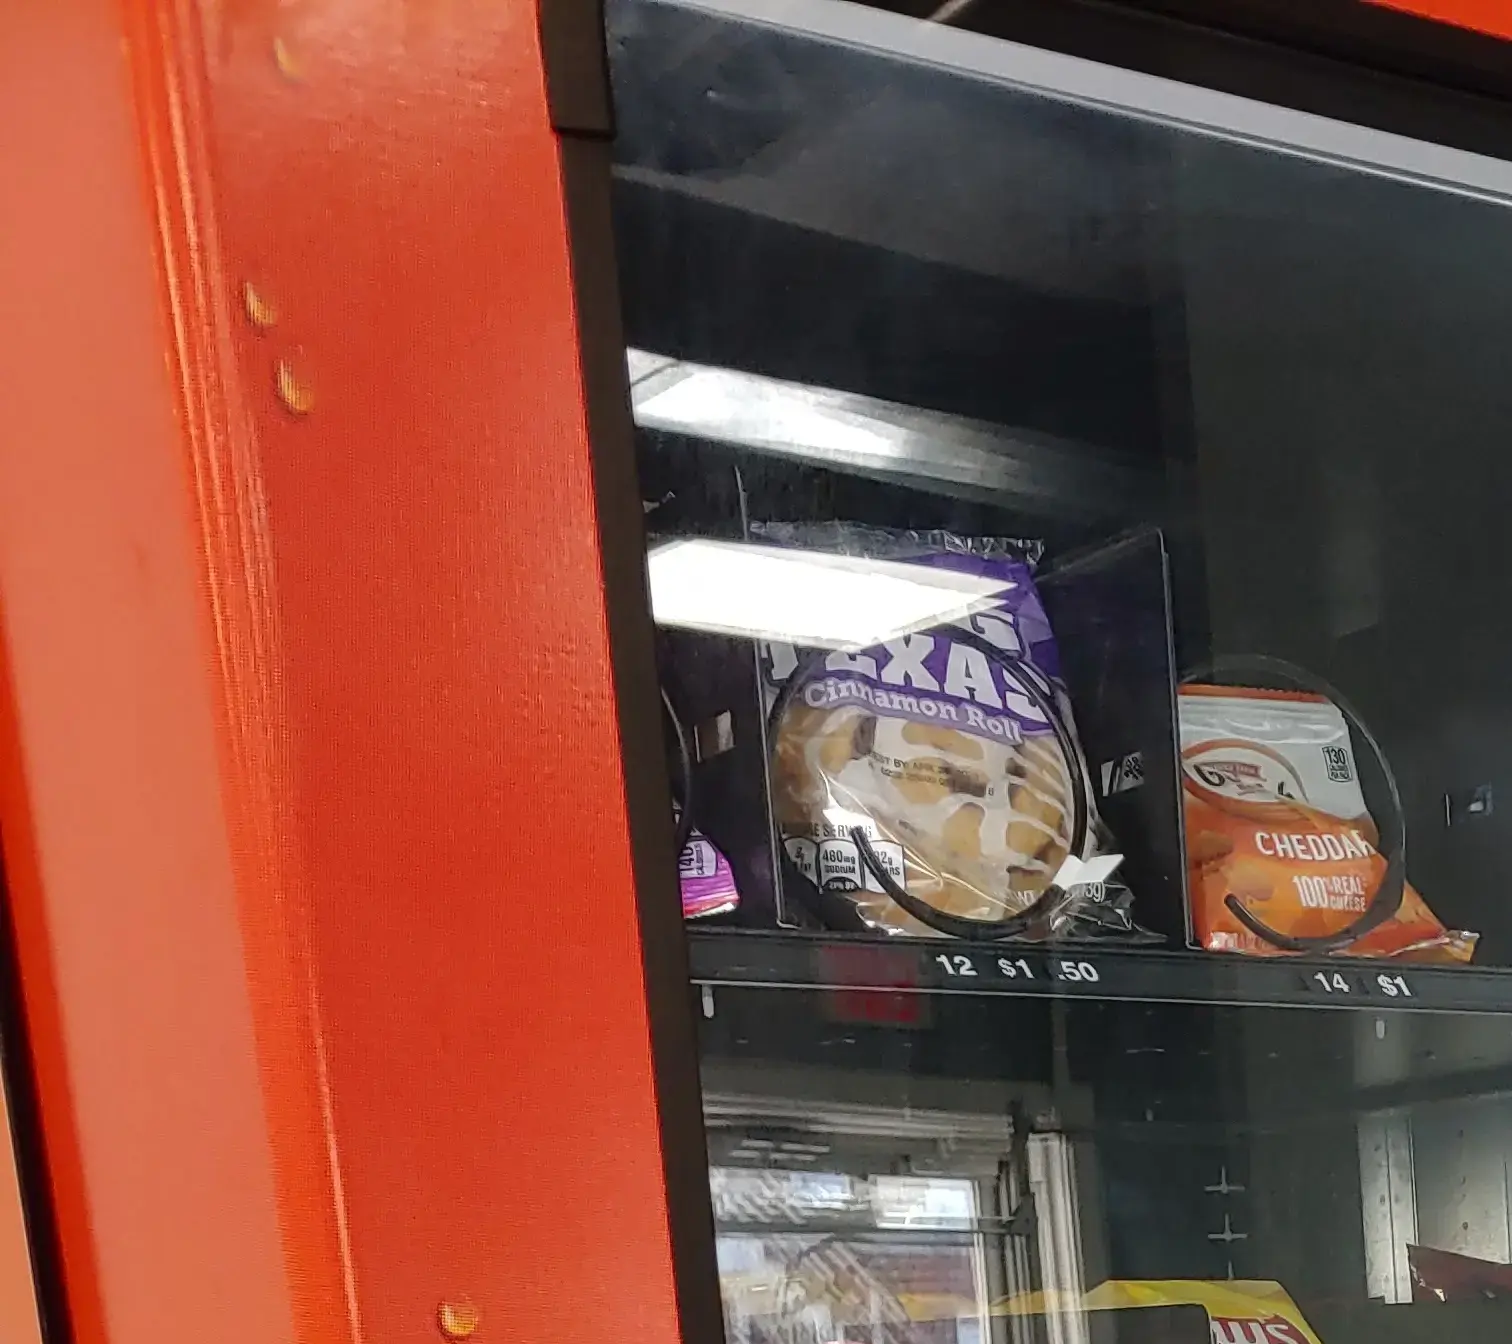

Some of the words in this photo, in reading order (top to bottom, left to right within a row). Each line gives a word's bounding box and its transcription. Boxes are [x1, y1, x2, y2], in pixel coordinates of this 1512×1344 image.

[805, 674, 962, 724] Cinnamon
[967, 705, 1026, 745] Roll
[1324, 748, 1345, 765] 130
[1255, 829, 1377, 861] CHEDDAR
[1333, 876, 1366, 896] REAL
[935, 953, 979, 978] 12
[998, 957, 1036, 982] $1
[1056, 960, 1100, 985] .50
[1313, 971, 1350, 993] 14
[1376, 974, 1413, 998] $1
